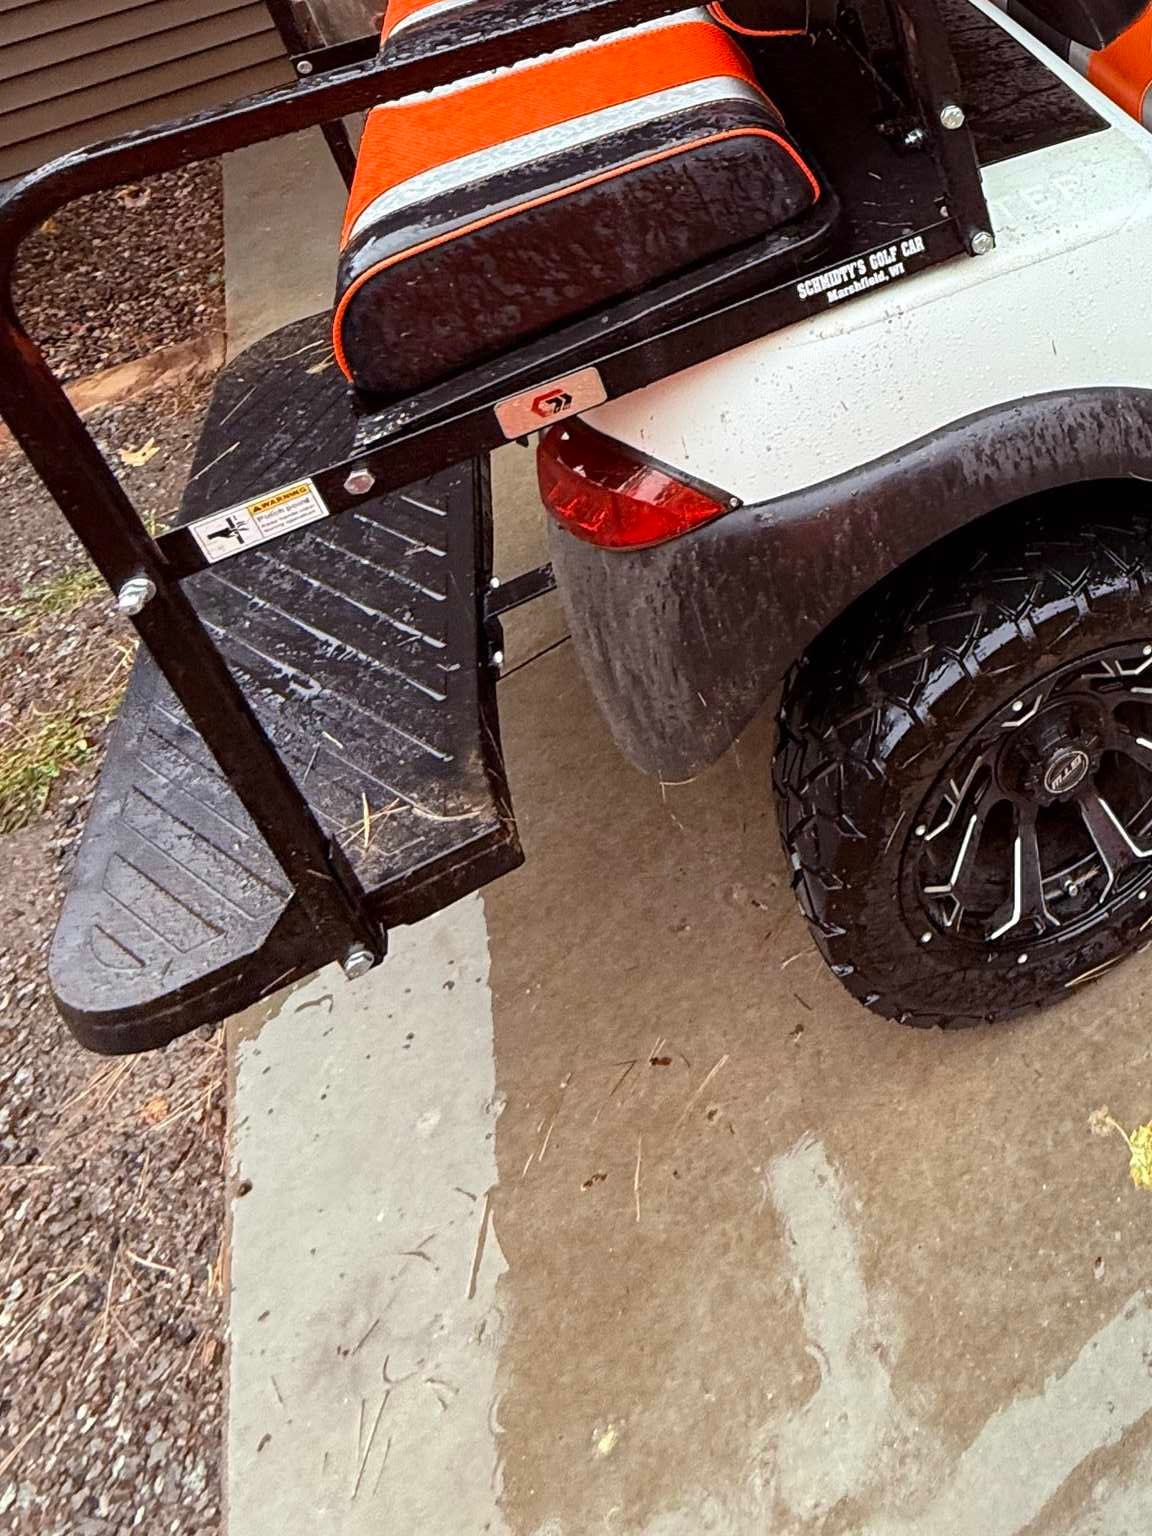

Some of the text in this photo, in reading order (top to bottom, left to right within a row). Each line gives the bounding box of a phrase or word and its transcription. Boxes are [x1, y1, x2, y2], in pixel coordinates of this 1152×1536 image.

[796, 235, 925, 299] SCHMIDTY'S GOLF CAR
[827, 262, 906, 303] Marshfield, WI
[261, 486, 307, 508] WARNING
